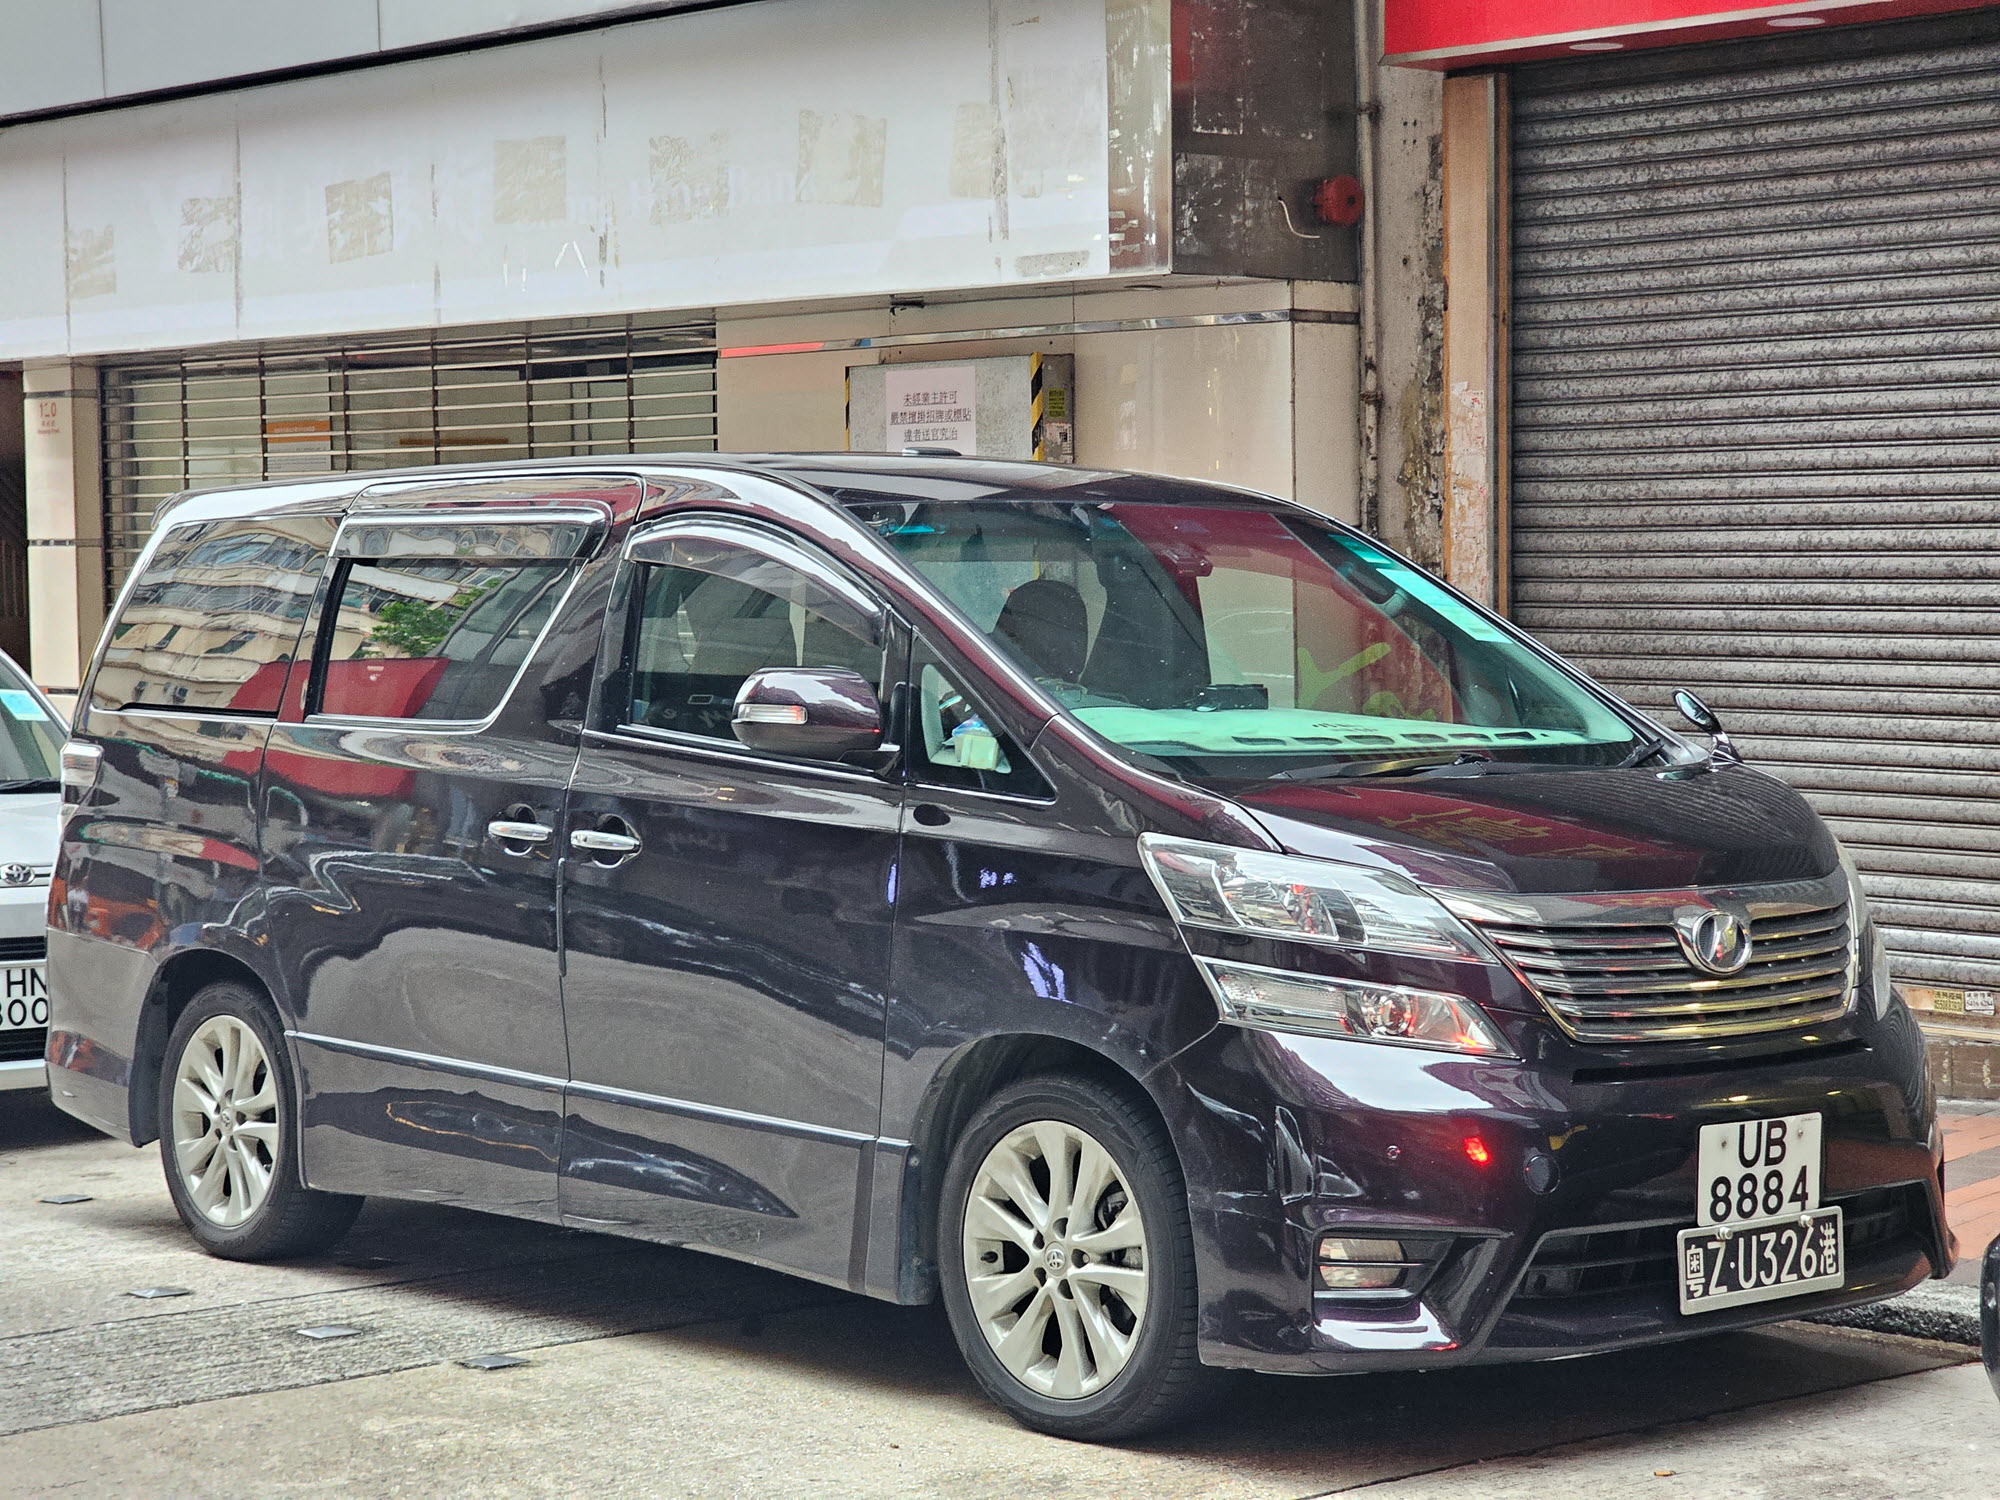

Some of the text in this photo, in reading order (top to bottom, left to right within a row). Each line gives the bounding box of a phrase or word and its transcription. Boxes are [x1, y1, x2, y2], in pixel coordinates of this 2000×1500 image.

[903, 390, 957, 406] 未經業主許可
[6, 967, 48, 997] HN
[1738, 1119, 1787, 1168] UB
[1709, 1165, 1809, 1223] 8884
